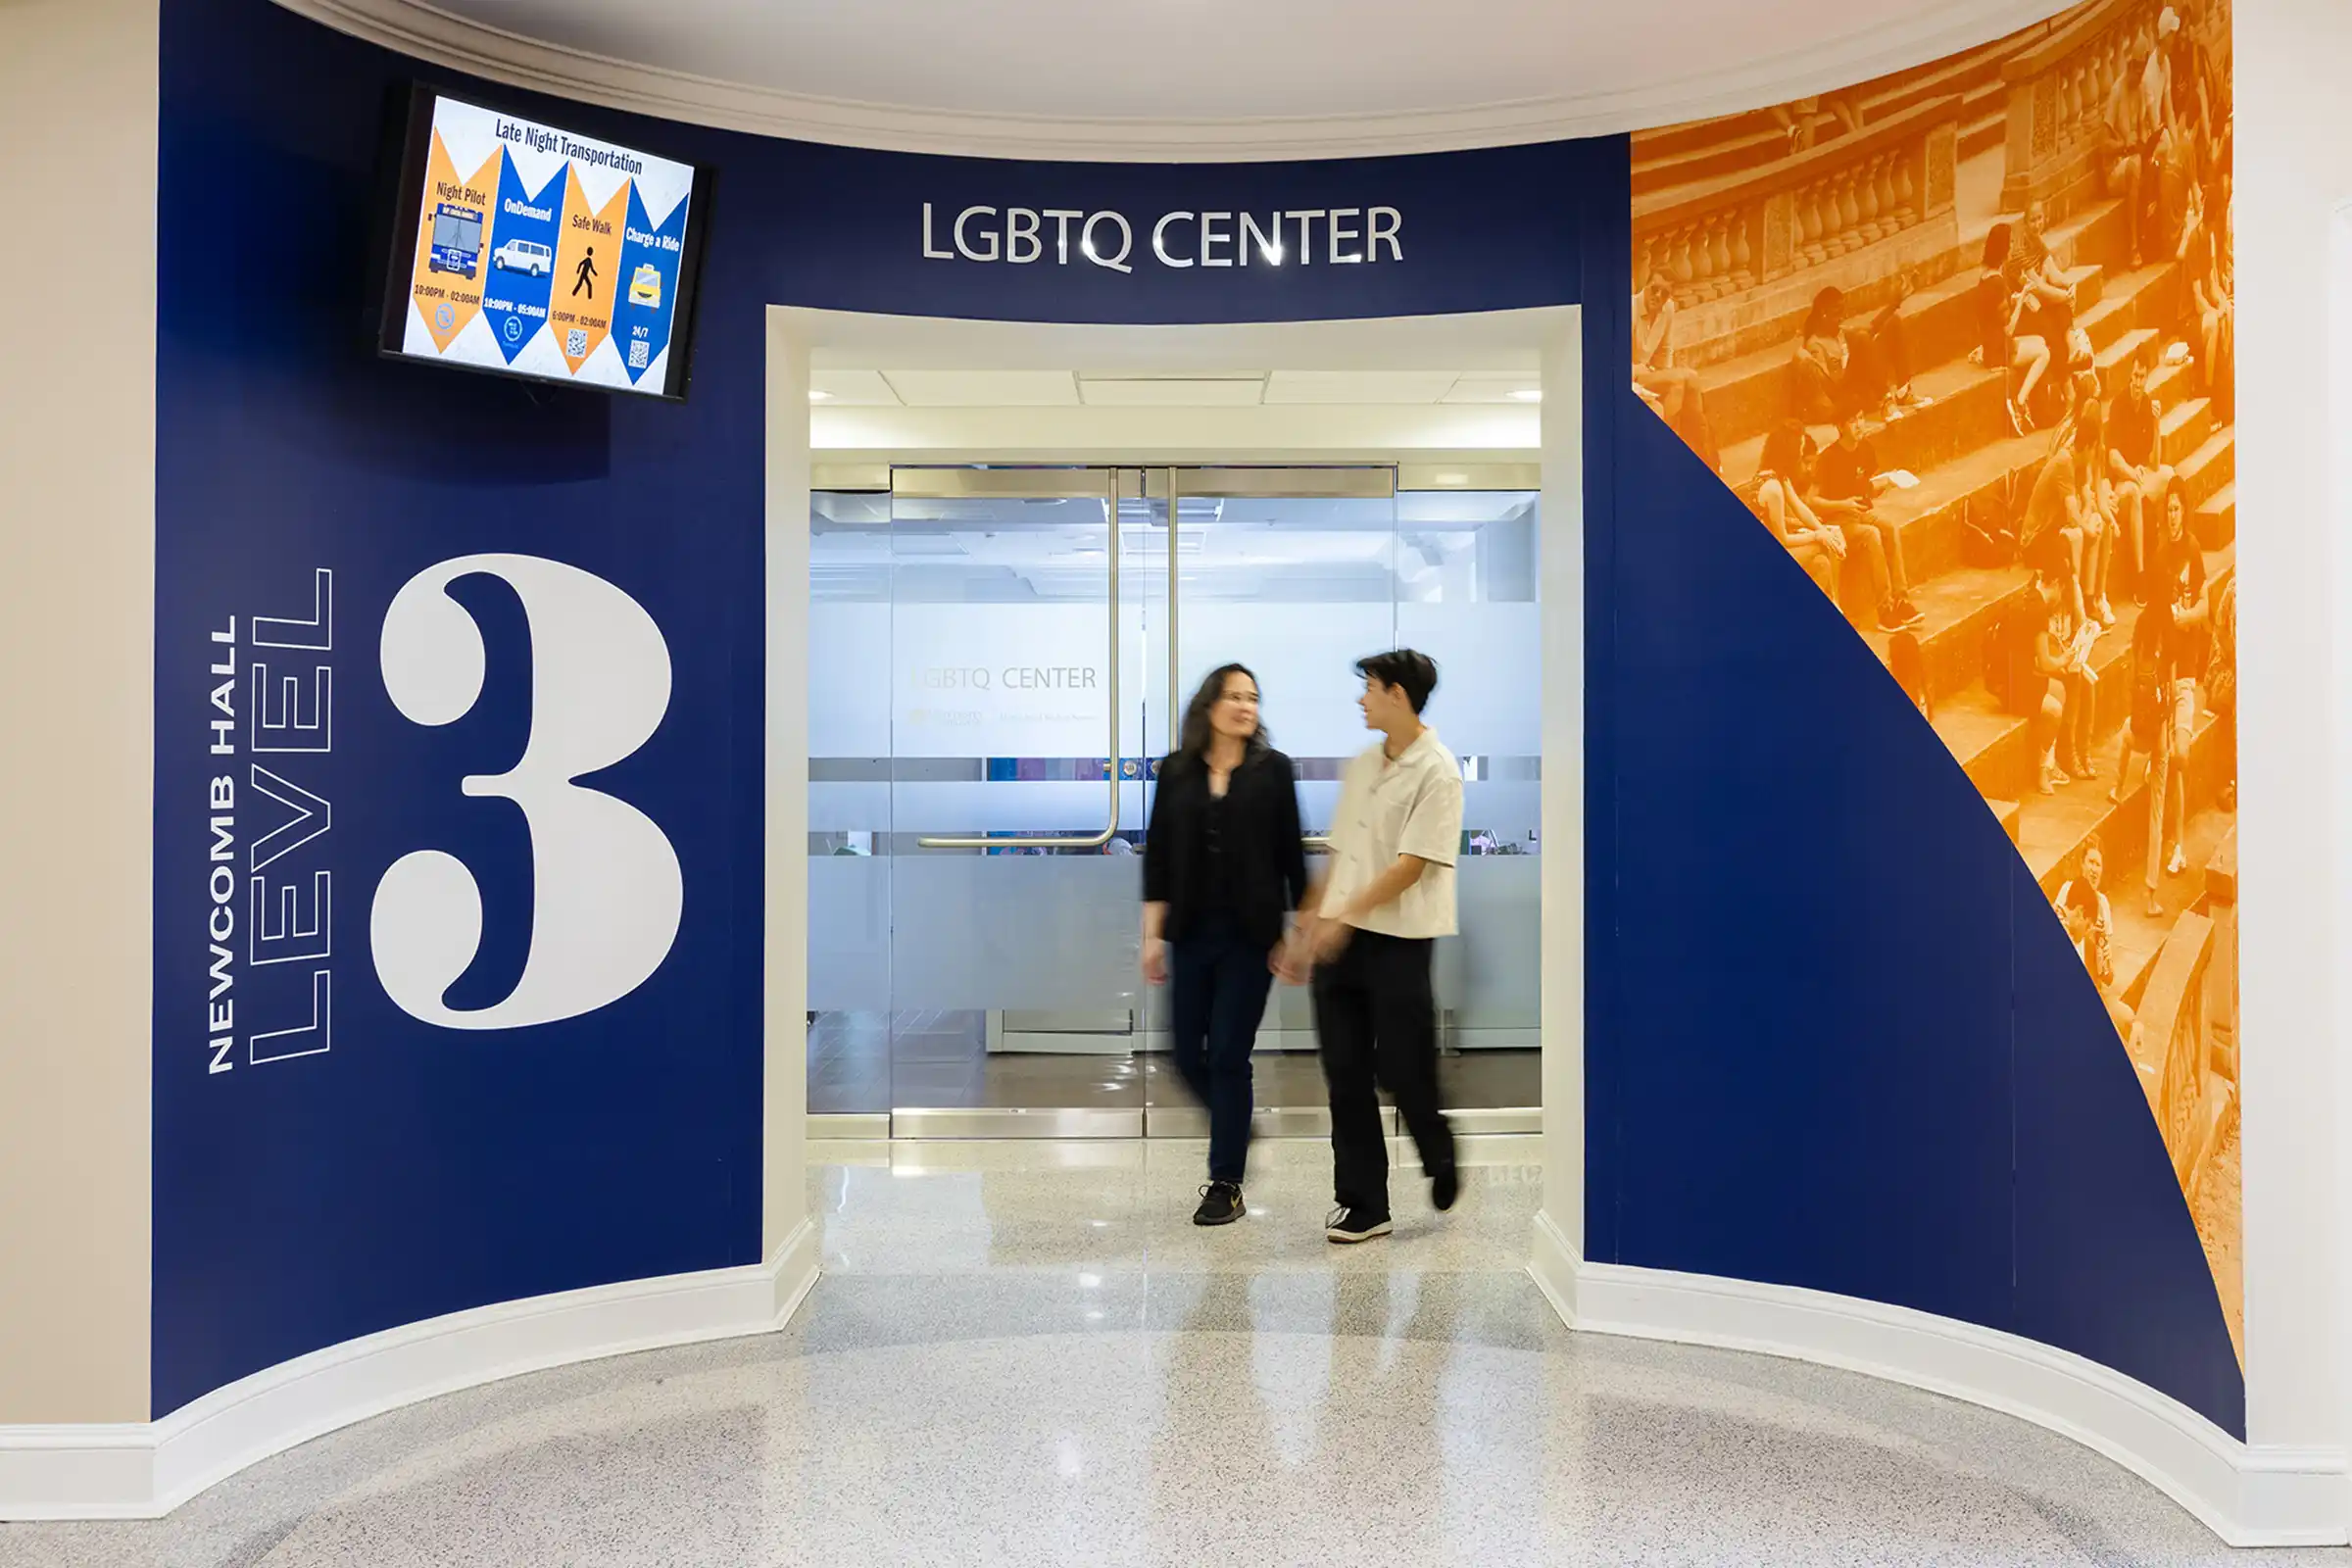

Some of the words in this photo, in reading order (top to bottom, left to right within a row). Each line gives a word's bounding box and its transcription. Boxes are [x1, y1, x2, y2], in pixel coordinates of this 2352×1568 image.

[495, 118, 522, 143] Late
[525, 126, 559, 154] Night
[561, 135, 643, 175] Transportation
[436, 181, 463, 202] Night
[464, 187, 487, 207] Pilot
[504, 197, 553, 224] OnDemand
[572, 214, 591, 231] Safe
[592, 218, 612, 236] Walk
[923, 202, 1132, 274] LGBTQ
[1152, 207, 1403, 268] CENTER
[625, 226, 655, 248] Charge
[655, 236, 662, 248] a
[662, 234, 681, 252] Ride
[415, 284, 446, 299] 10:00PM
[450, 290, 481, 307] 02:00AM
[552, 310, 576, 324] 6:00PM
[631, 324, 649, 339] 24/7
[210, 614, 236, 756] HALL
[1002, 666, 1098, 689] CENTER
[369, 553, 684, 1030] 3
[249, 567, 333, 1065] LEVEL
[209, 774, 234, 1075] NEWCOMB
